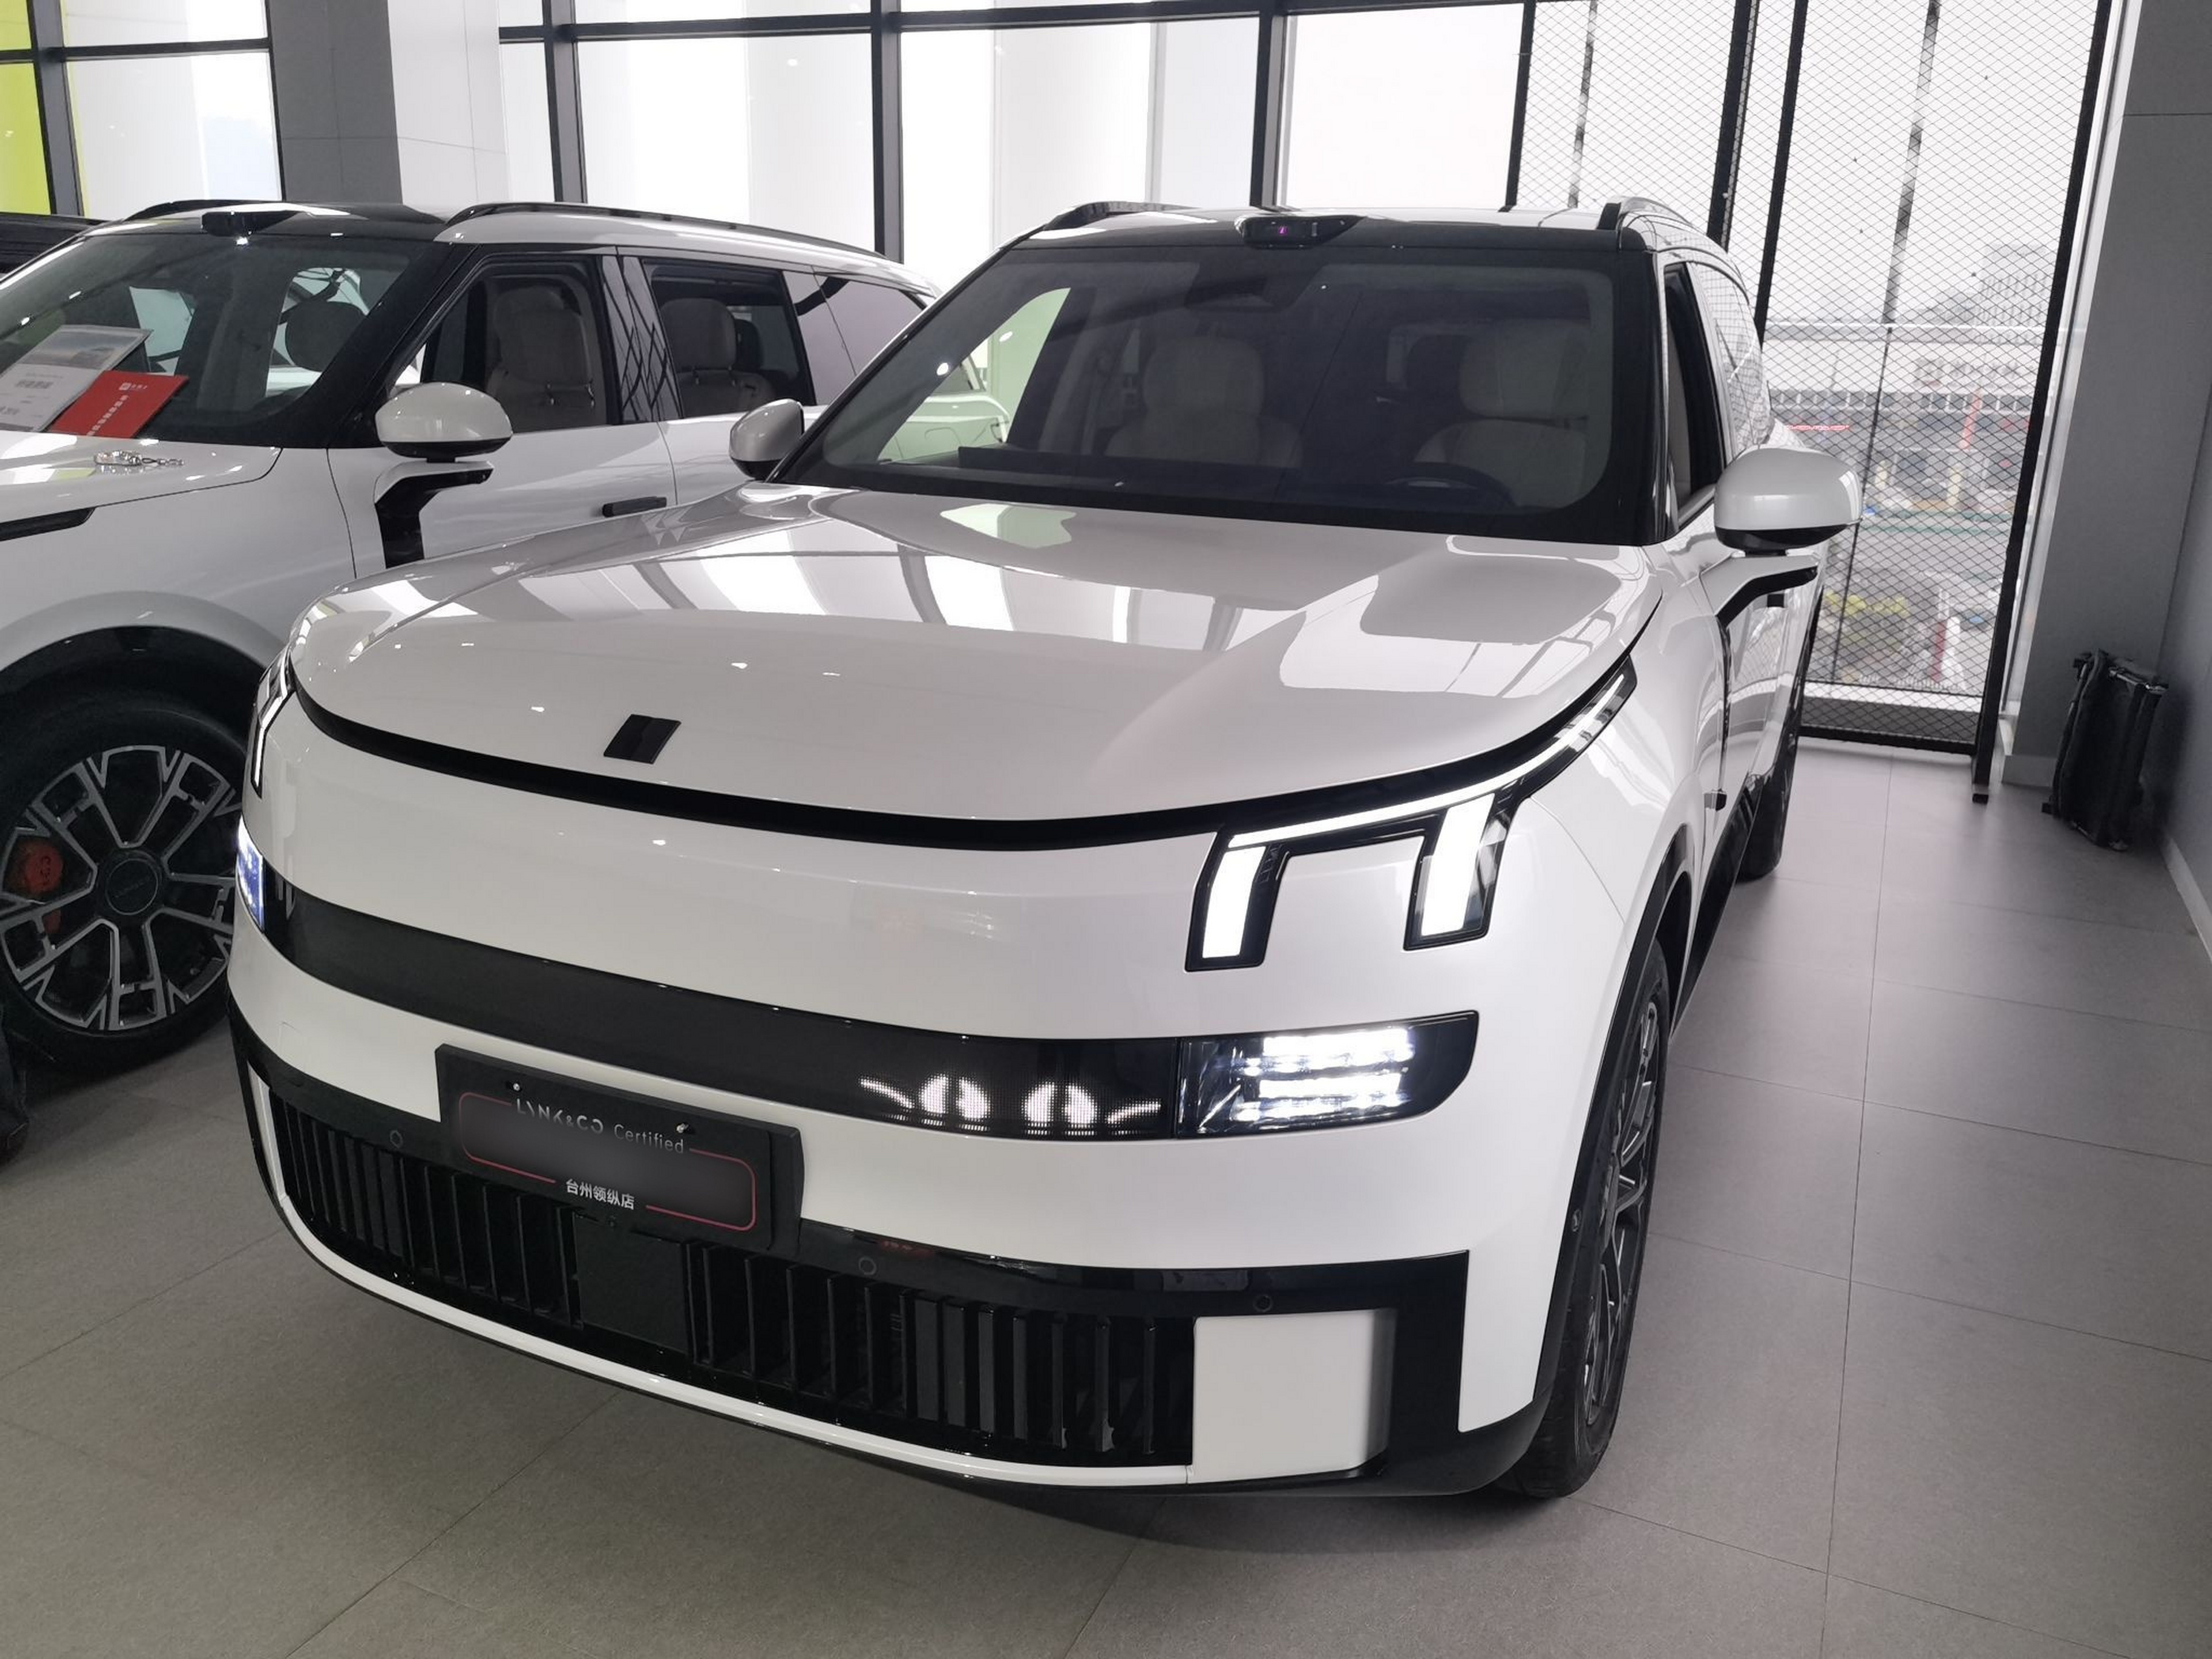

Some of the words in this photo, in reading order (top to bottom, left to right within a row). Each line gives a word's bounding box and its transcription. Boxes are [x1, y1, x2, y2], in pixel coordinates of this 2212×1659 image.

[613, 1124, 684, 1153] Certified
[566, 1179, 634, 1210] 台州领纵店
